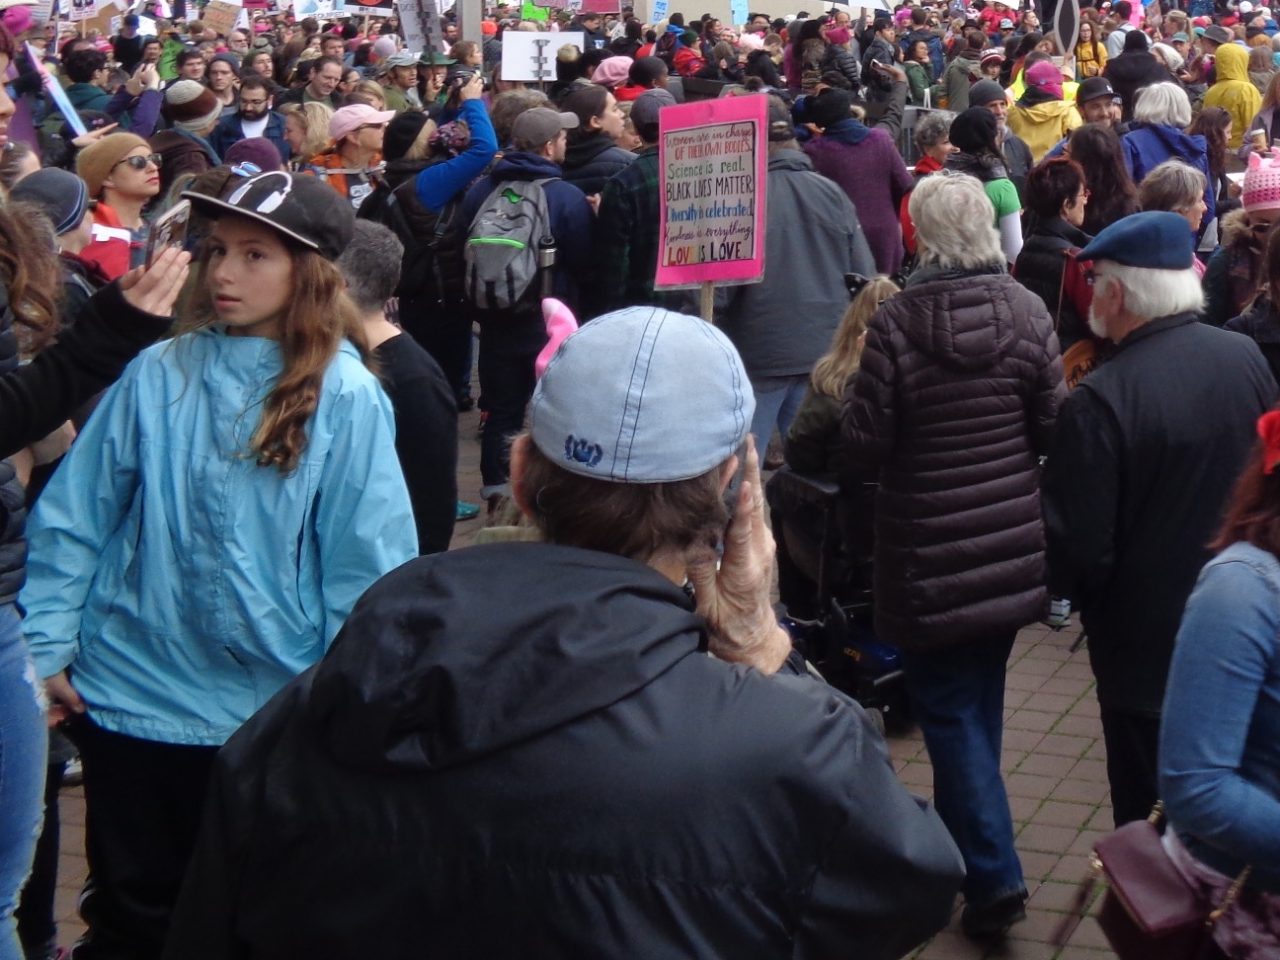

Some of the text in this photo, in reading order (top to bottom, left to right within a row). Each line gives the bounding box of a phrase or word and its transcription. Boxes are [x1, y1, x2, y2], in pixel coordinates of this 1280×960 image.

[675, 146, 685, 160] OF
[668, 163, 703, 180] Science
[705, 161, 713, 175] is
[666, 181, 691, 201] BLACK
[694, 178, 712, 198] LIVES
